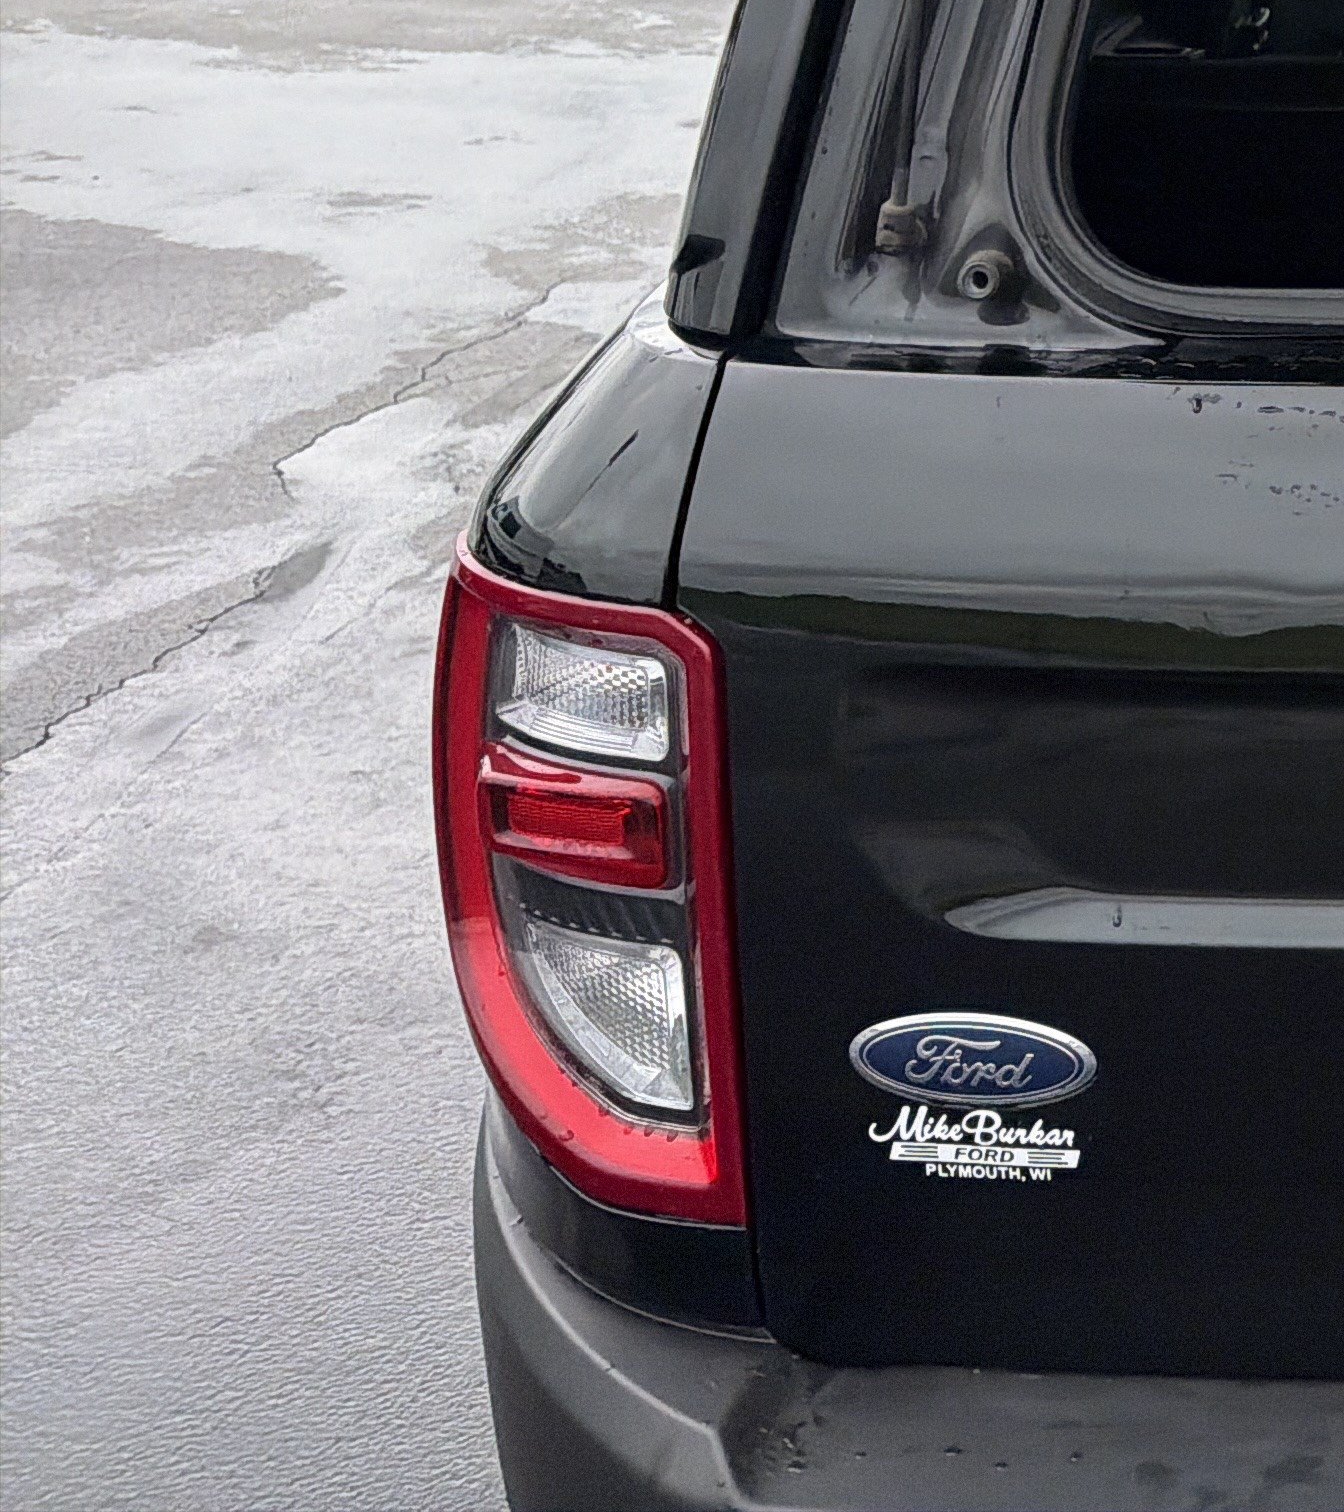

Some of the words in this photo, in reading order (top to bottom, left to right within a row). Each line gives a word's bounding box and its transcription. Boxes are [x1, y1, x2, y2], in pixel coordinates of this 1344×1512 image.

[905, 1035, 1034, 1088] Ford
[868, 1106, 963, 1142] Mike
[954, 1148, 1015, 1163] FORD
[925, 1164, 1028, 1182] PLYMOUTH,
[1028, 1168, 1052, 1181] WI
